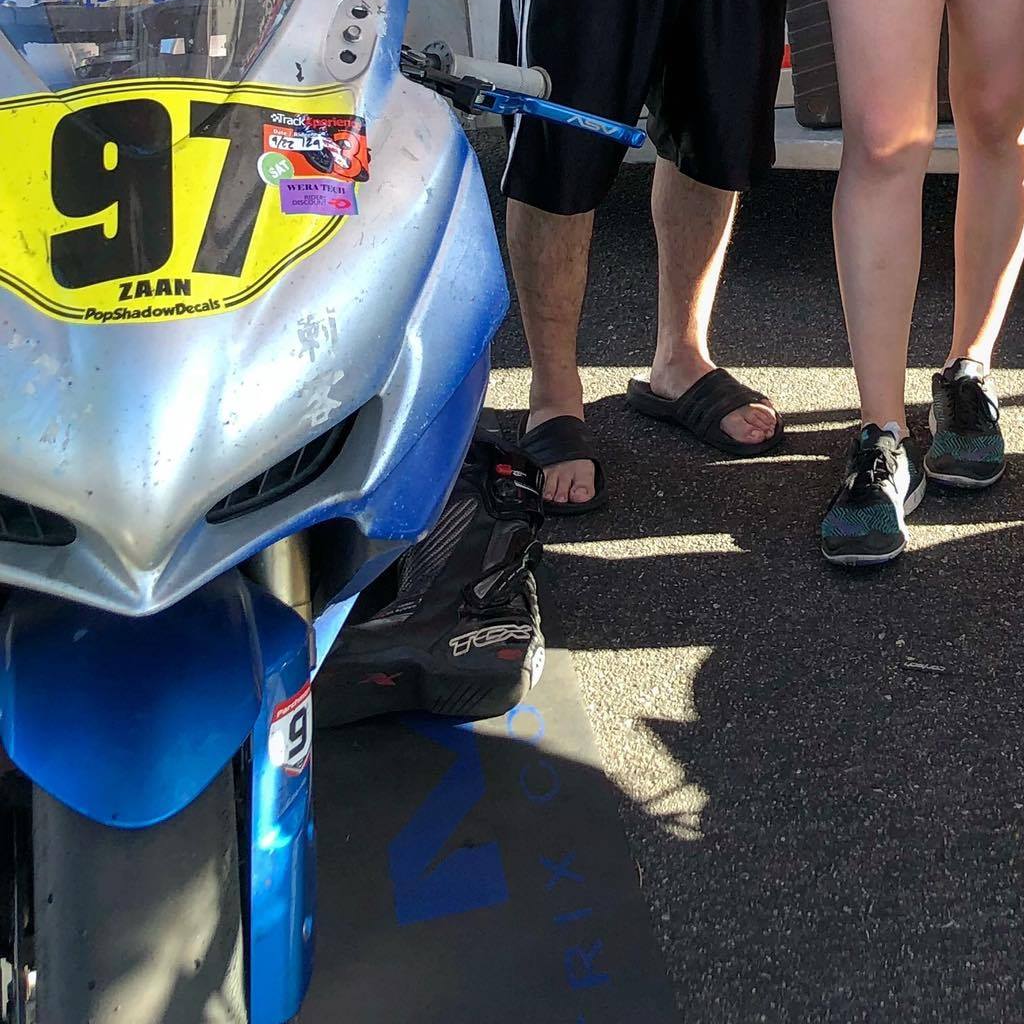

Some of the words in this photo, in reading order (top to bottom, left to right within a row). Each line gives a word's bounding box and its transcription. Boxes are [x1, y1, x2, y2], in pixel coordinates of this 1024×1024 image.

[566, 115, 623, 140] ASV
[268, 159, 290, 179] SAT
[50, 98, 272, 290] 97
[286, 183, 319, 192] WERA
[320, 183, 346, 195] TECH
[118, 278, 191, 302] ZAAN
[84, 298, 221, 323] PopShadowDecals
[448, 624, 533, 657] TCX
